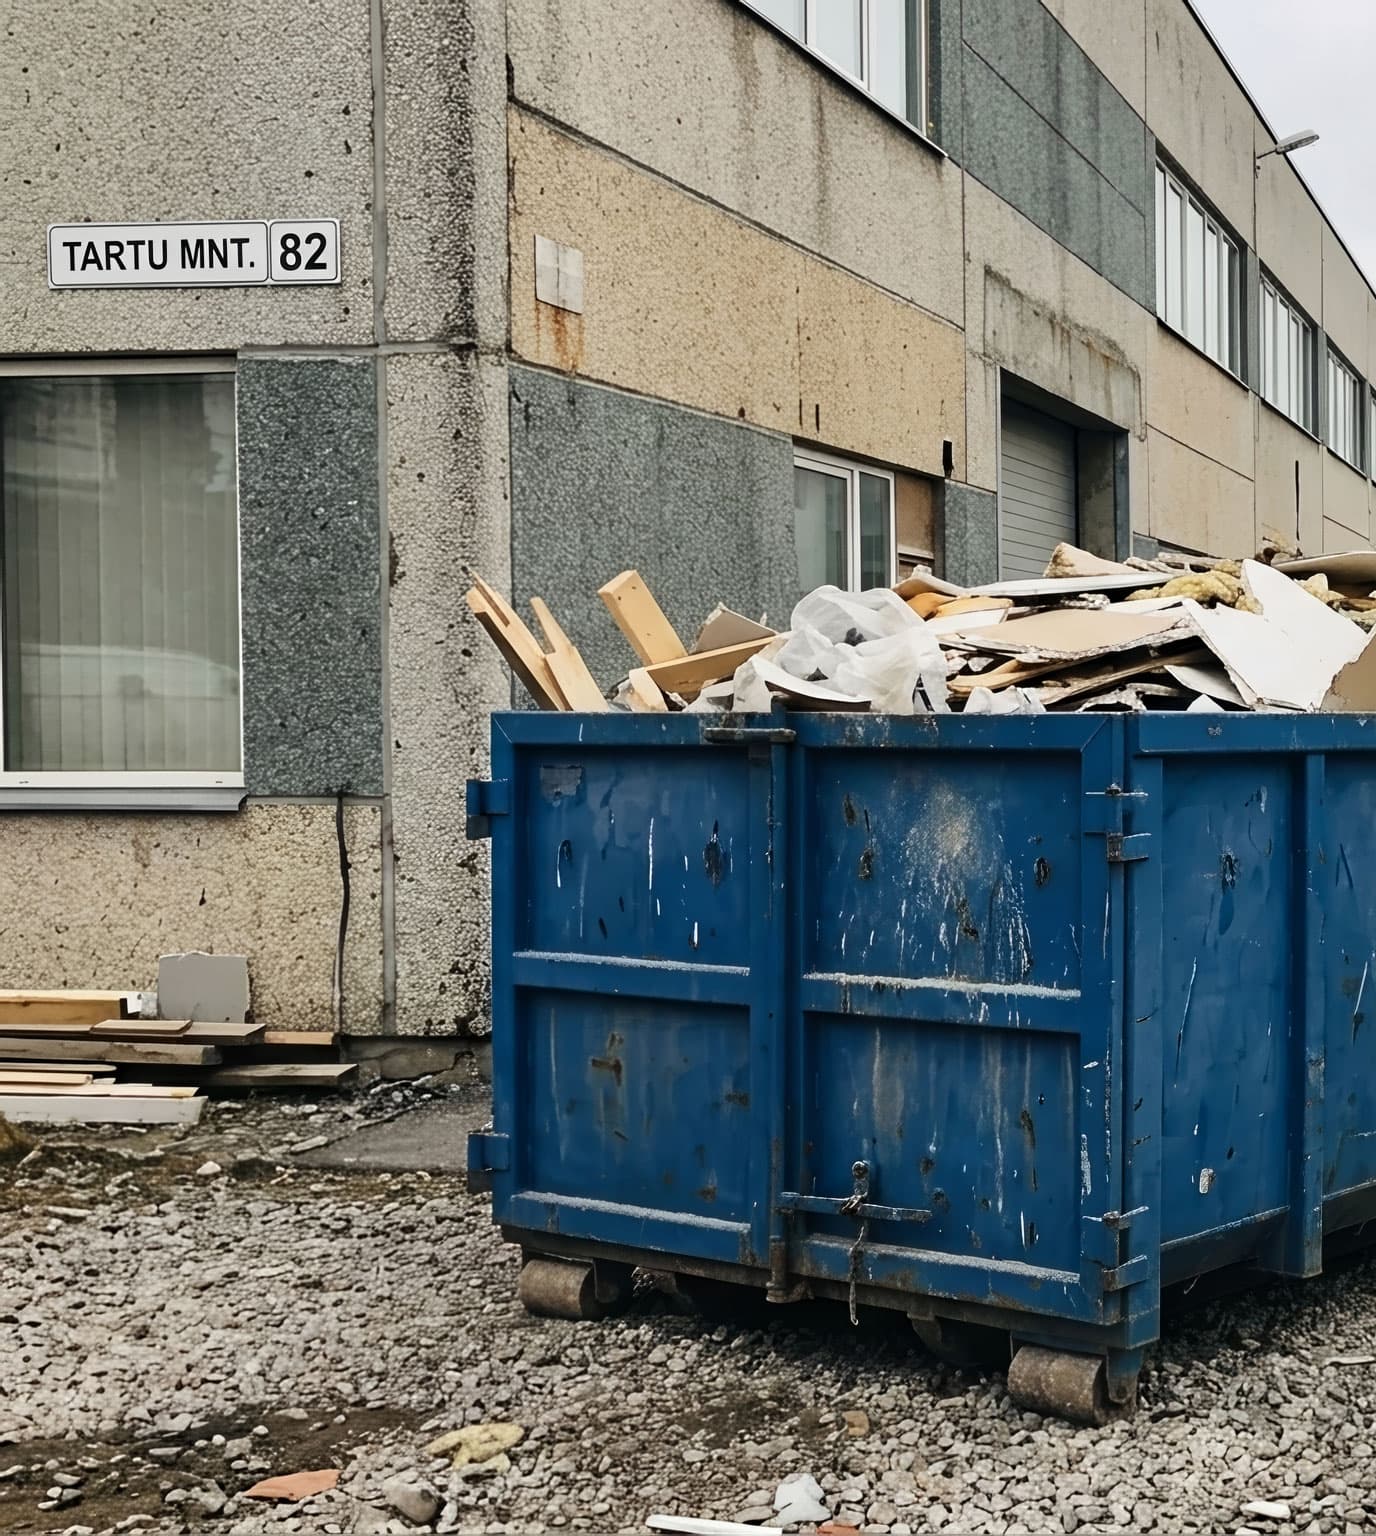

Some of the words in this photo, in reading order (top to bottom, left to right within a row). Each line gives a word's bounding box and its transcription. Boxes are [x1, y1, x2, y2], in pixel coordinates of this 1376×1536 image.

[62, 239, 168, 271] TARTU
[180, 237, 255, 270] MNT.
[279, 232, 328, 272] 82
